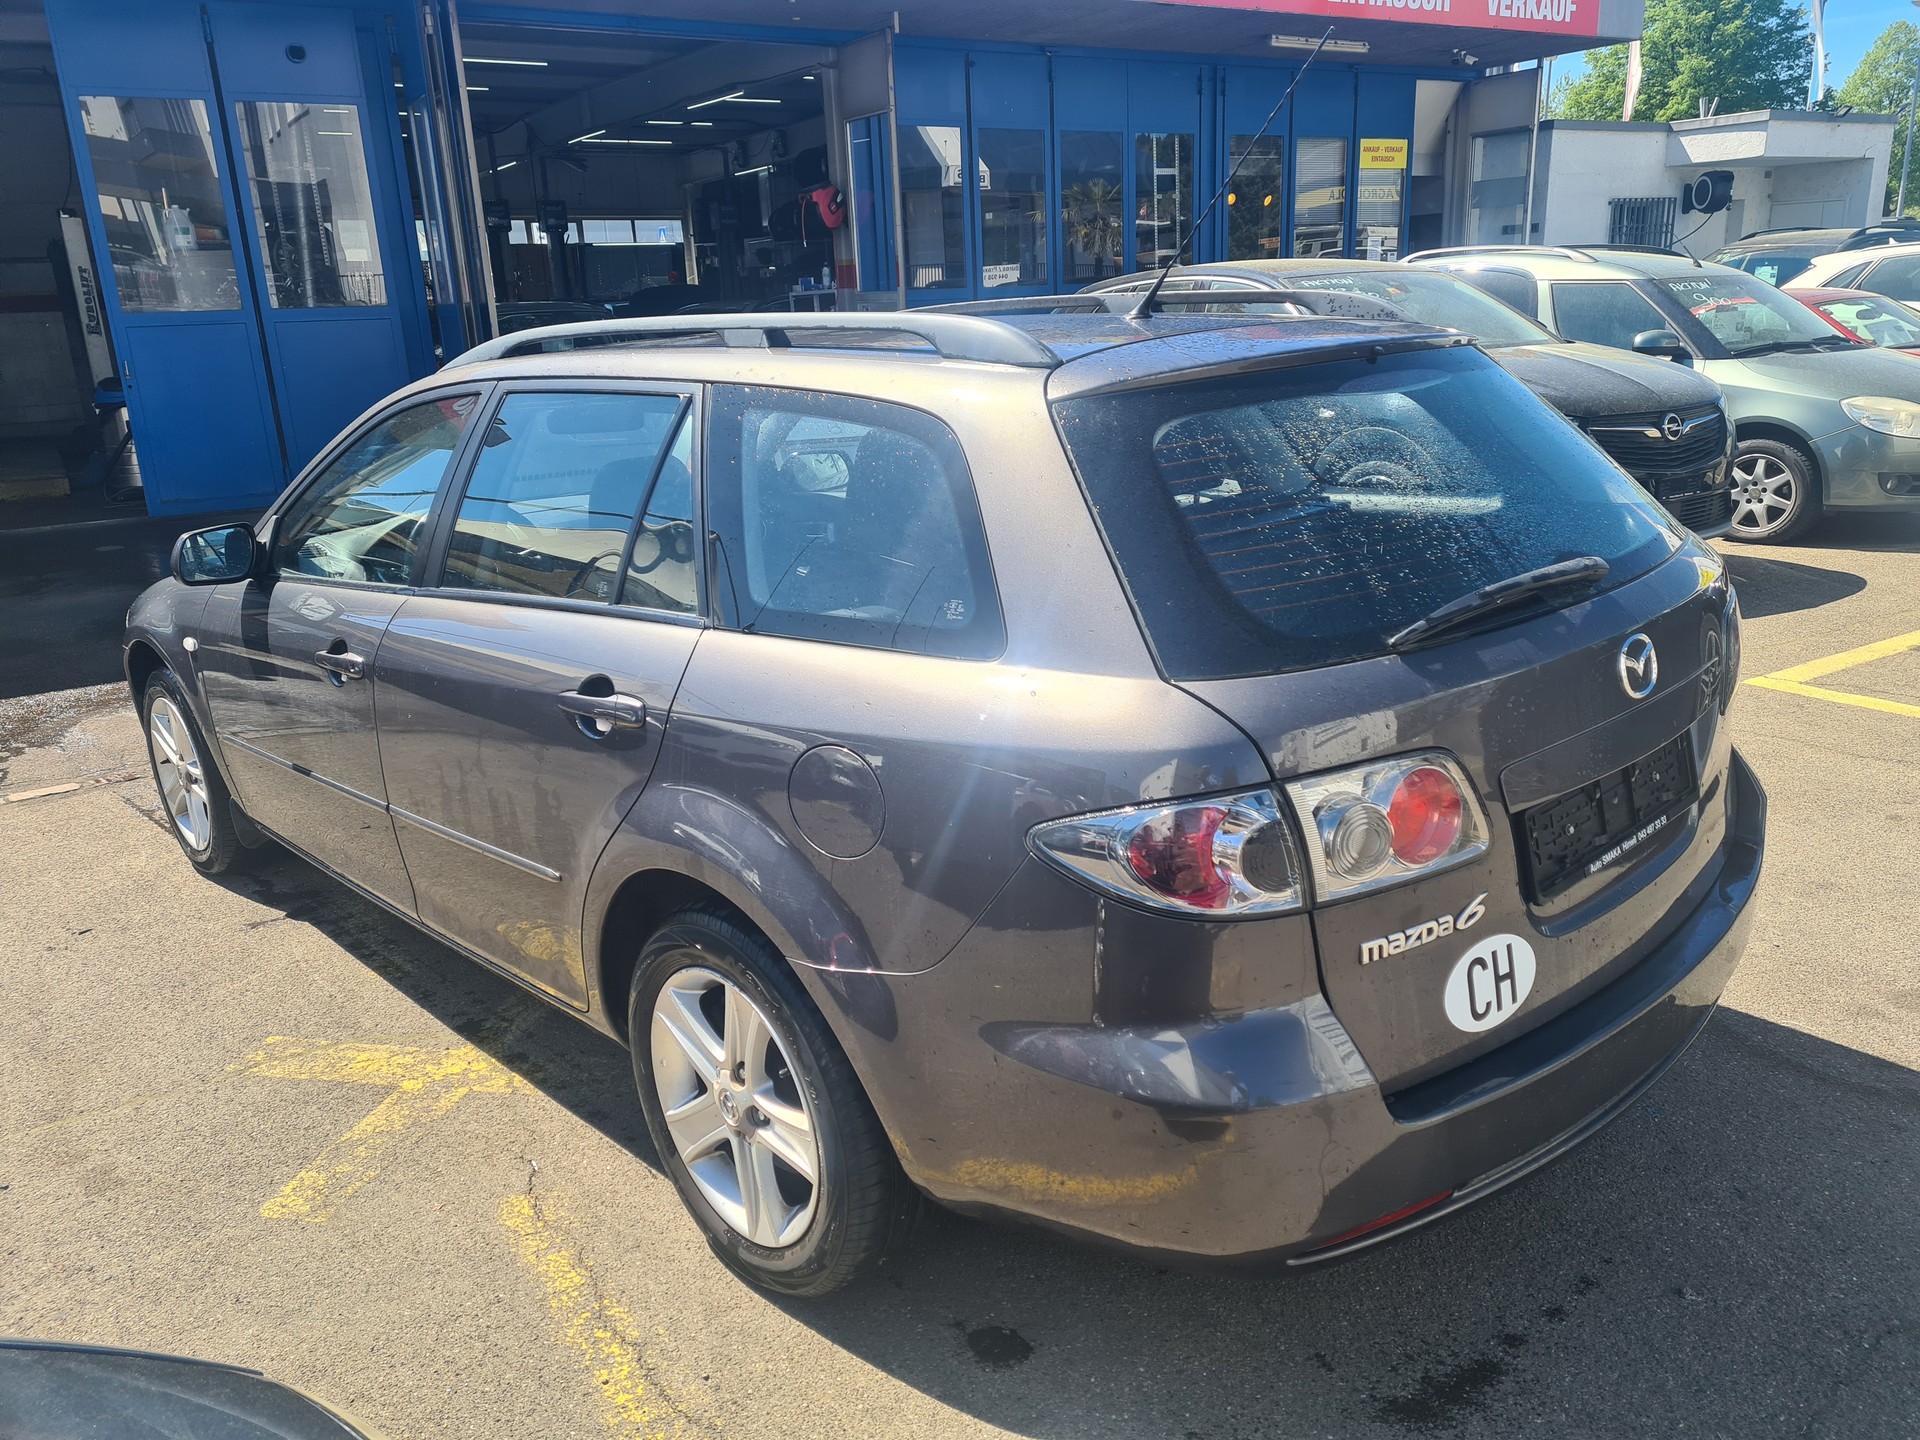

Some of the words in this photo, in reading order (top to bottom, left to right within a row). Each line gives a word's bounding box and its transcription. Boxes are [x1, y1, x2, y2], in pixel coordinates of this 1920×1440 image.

[1487, 0, 1576, 22] VERKAUF
[1590, 860, 1603, 874] Auto
[1602, 846, 1621, 864] SMAKA
[1467, 942, 1518, 1023] CH
